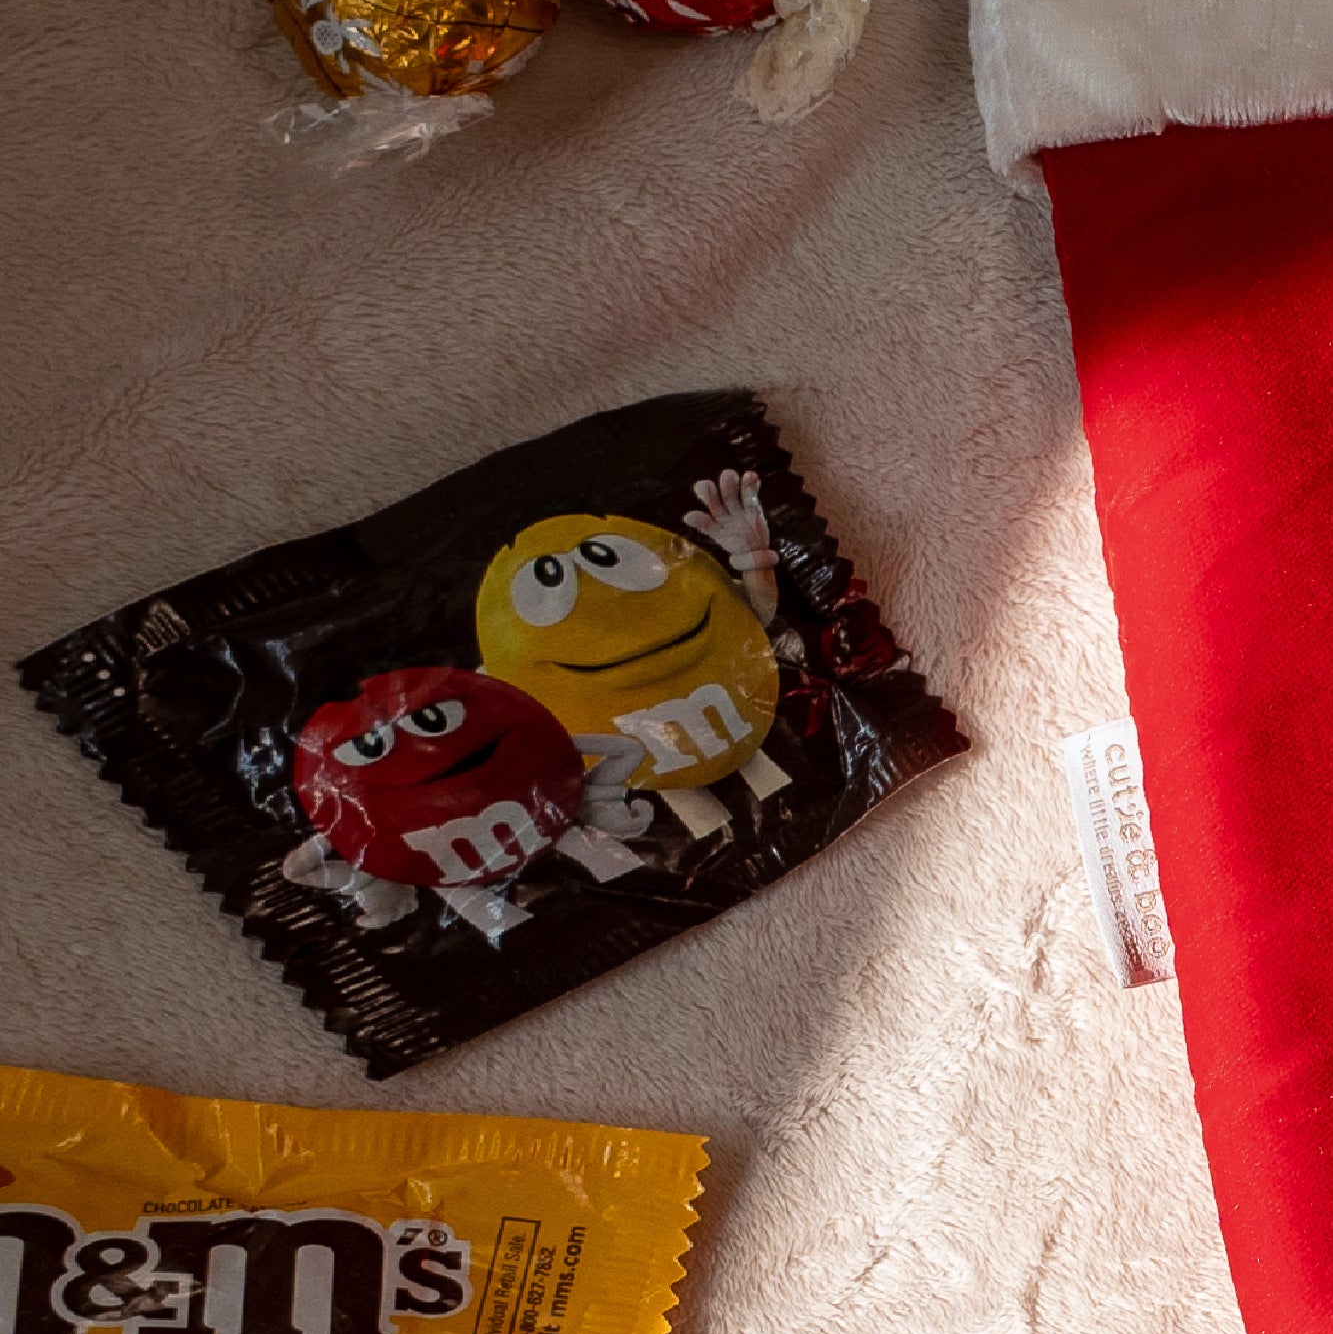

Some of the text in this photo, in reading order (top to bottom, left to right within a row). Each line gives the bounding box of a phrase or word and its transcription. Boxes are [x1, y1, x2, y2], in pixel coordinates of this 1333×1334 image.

[613, 683, 753, 774] m
[401, 801, 552, 884] m
[551, 1225, 586, 1317] mms.com
